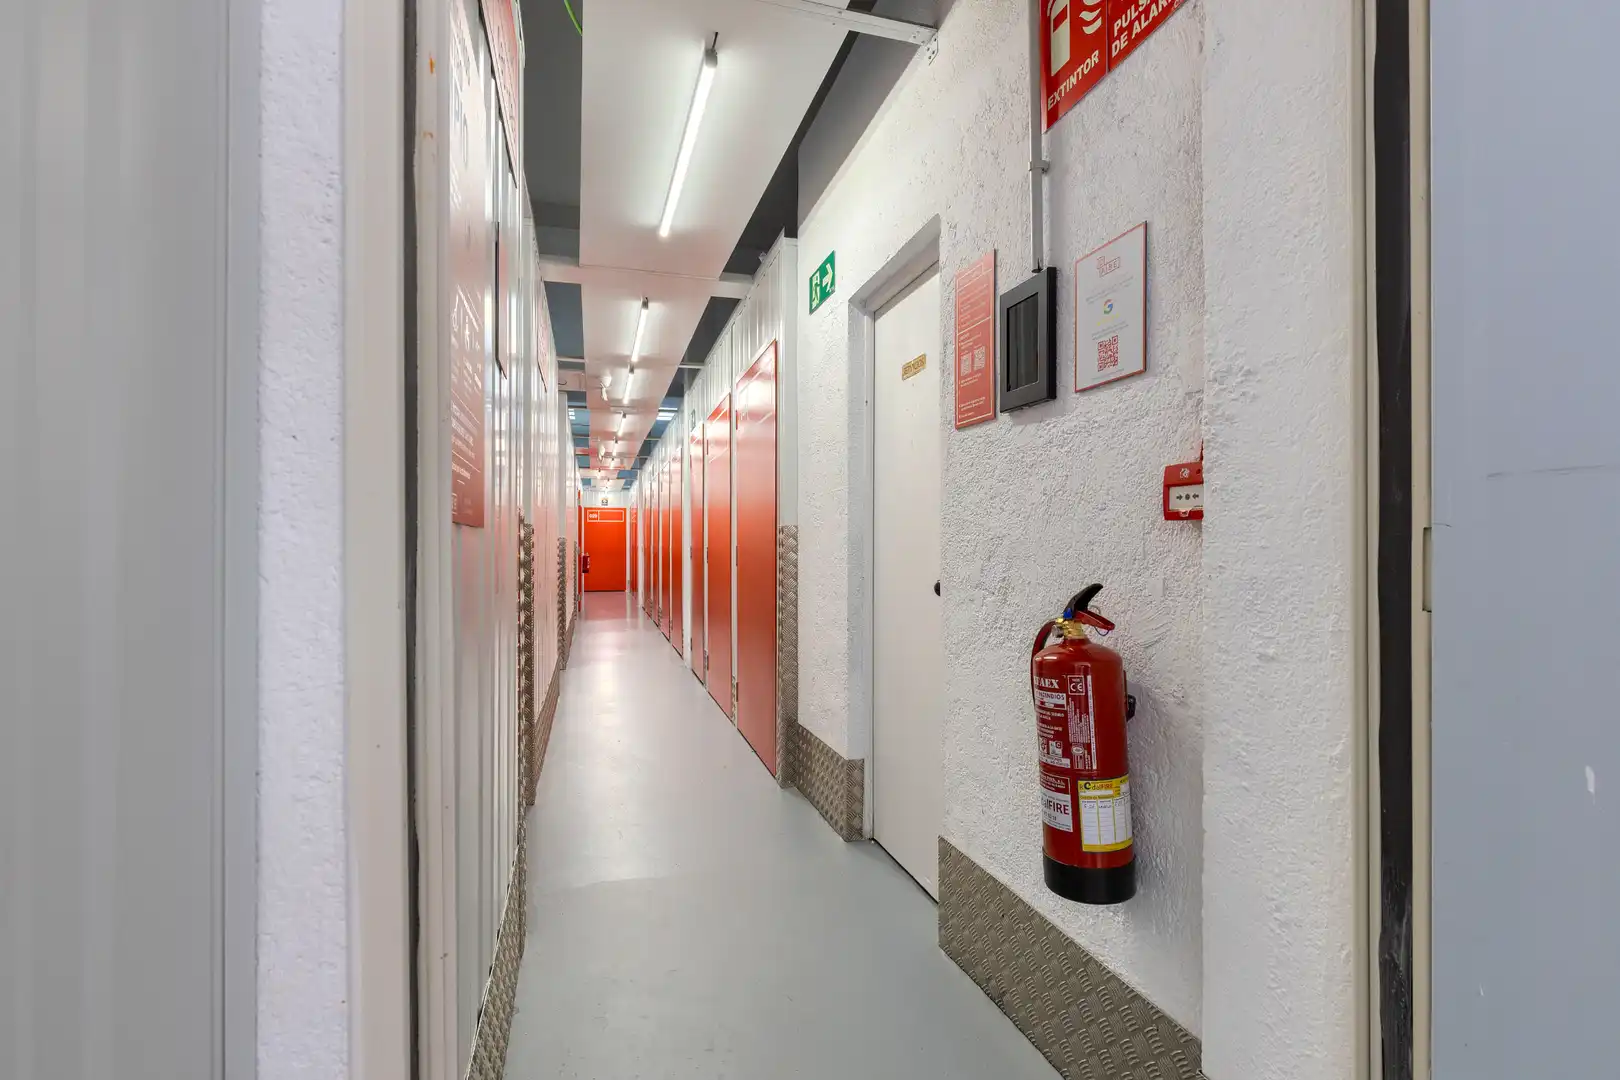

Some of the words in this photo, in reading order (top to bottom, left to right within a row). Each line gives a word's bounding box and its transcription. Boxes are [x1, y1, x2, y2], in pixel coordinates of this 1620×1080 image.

[1111, 31, 1128, 58] DE
[1131, 0, 1172, 40] ALAR
[1113, 0, 1150, 38] PULS
[1047, 49, 1100, 111] EXTINTOR
